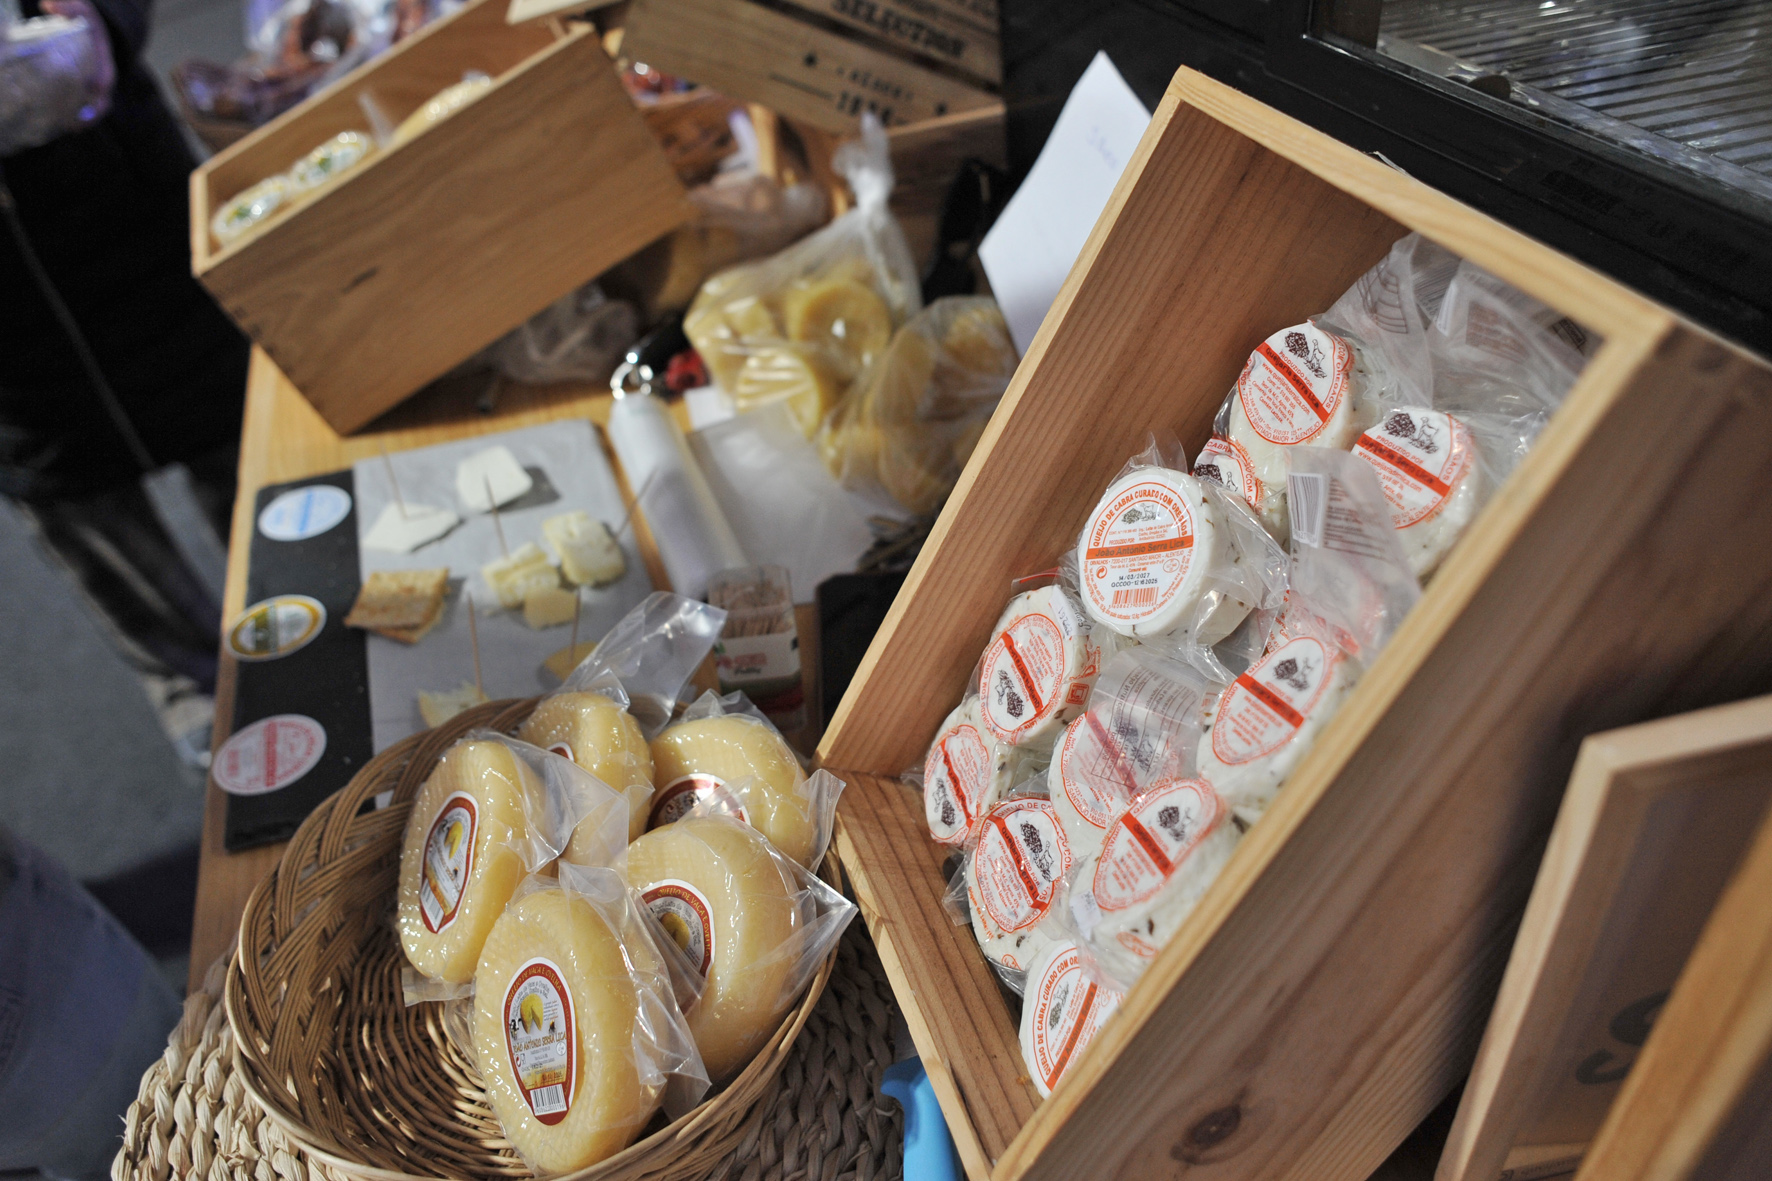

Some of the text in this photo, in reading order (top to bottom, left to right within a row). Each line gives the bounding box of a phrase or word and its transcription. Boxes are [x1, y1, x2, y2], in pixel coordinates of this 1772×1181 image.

[1266, 348, 1292, 376] Queijaria
[1292, 374, 1308, 395] Serra
[1279, 351, 1305, 378] PRODUZIDO
[1272, 434, 1290, 442] MAIOR
[1295, 421, 1320, 440] ALENTEJO
[1093, 520, 1108, 547] QUEIJO
[1106, 510, 1115, 521] DE
[1114, 494, 1134, 511] CABRA
[1134, 489, 1160, 499] CURADO
[1096, 540, 1184, 557] João António Serra Lica
[1165, 550, 1184, 558] ALENTEJO
[1016, 660, 1028, 679] Serra
[1025, 680, 1040, 709] Queijaria
[1065, 716, 1084, 751] ORVALHOS
[1089, 814, 1106, 826] MAIOR
[1002, 827, 1021, 865] Queijaria
[1014, 836, 1032, 872] PRODUZIDO
[691, 897, 705, 916] VACA
[546, 969, 562, 992] OVELHA
[1037, 959, 1069, 1075] QUEIJO DE CABRA CURADO COM
[556, 1031, 567, 1044] LICA
[1054, 1055, 1068, 1080] João
[1065, 1018, 1083, 1055] António
